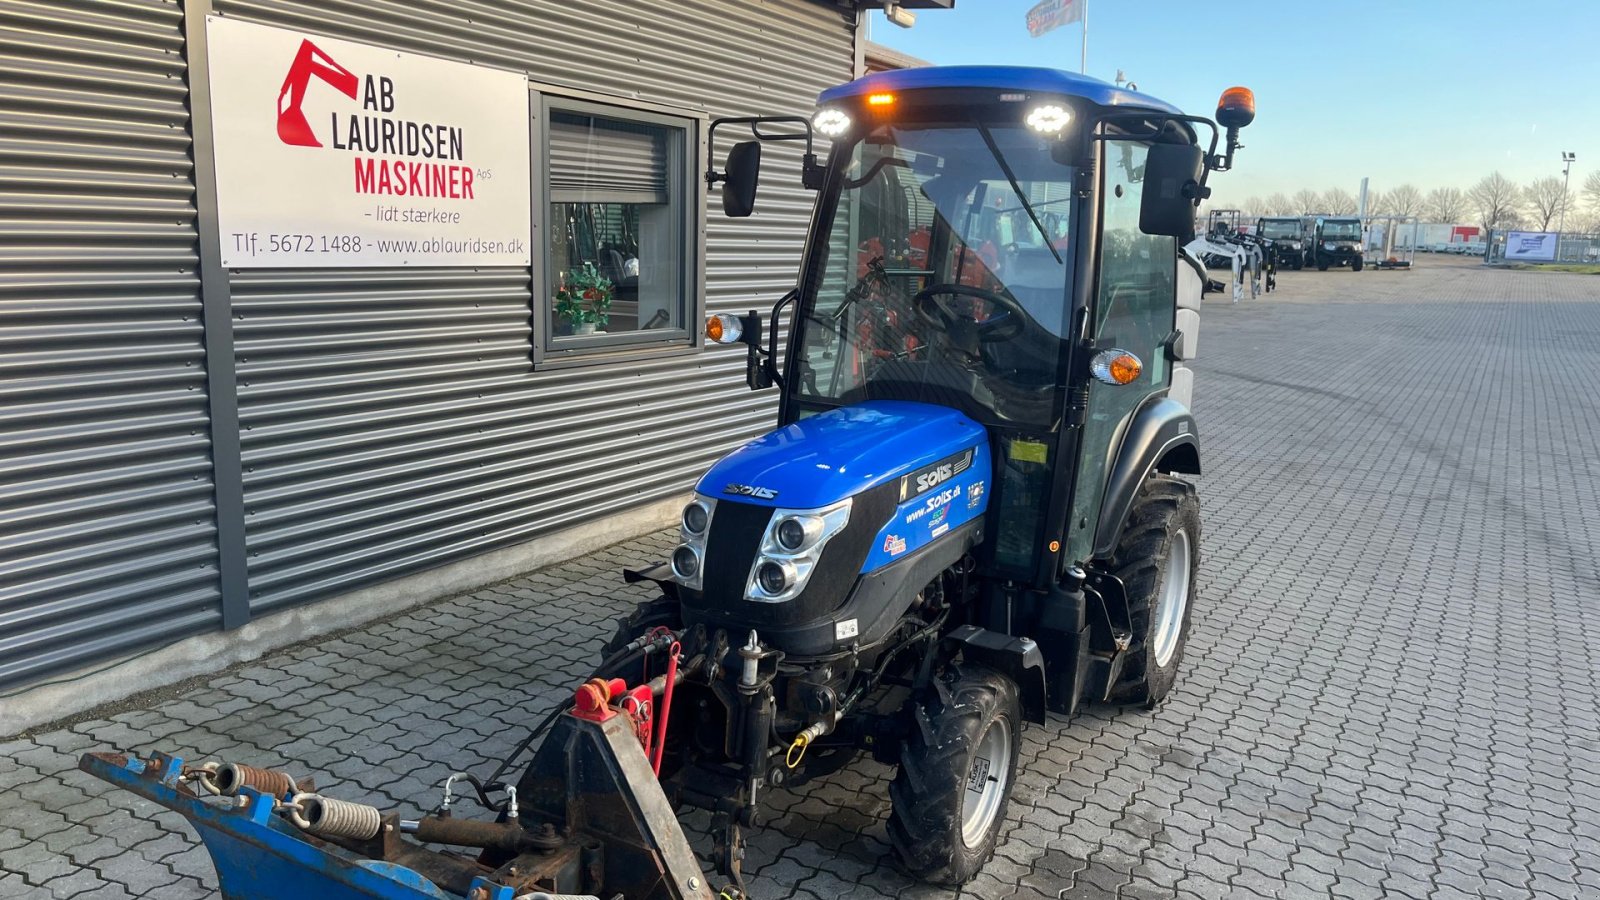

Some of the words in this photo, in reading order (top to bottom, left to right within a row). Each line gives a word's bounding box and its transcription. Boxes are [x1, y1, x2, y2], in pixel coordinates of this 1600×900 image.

[363, 74, 395, 113] AB
[331, 112, 463, 161] LAURIDSEN
[354, 157, 474, 200] MASKINER
[476, 168, 492, 180] ApS
[376, 205, 399, 222] lidt
[402, 207, 461, 224] stærkere
[232, 233, 263, 257] Tlf.
[270, 234, 315, 253] 5672
[320, 235, 362, 253] 1488
[377, 237, 524, 254] www.ablauridsen.dk
